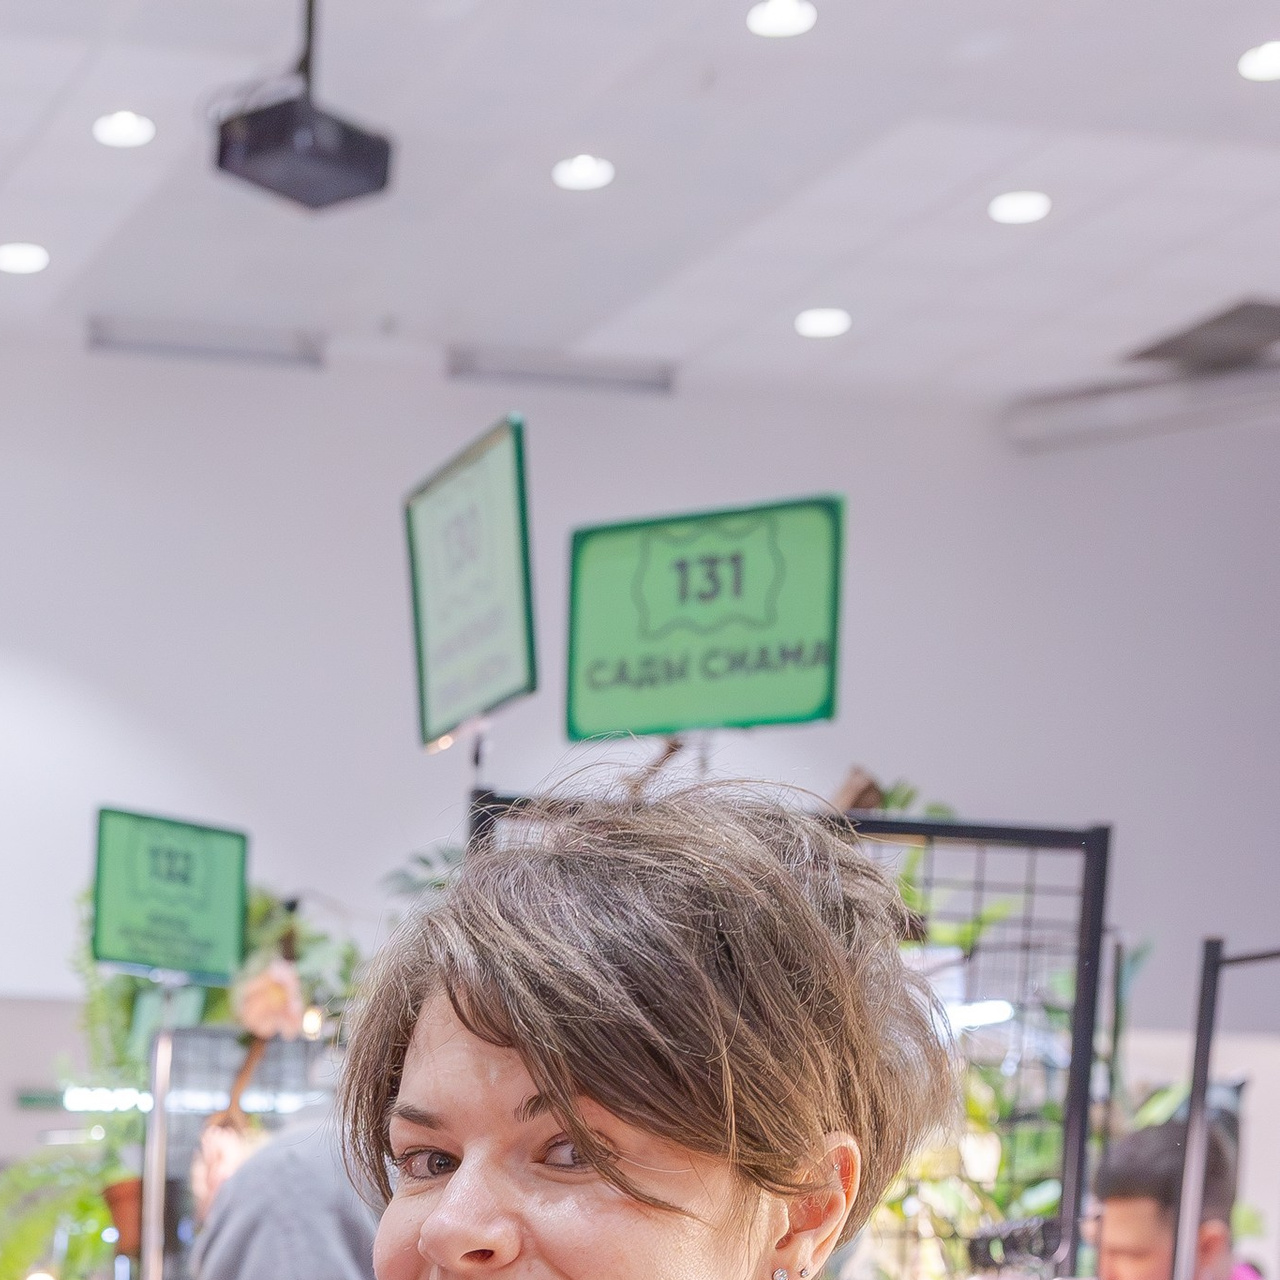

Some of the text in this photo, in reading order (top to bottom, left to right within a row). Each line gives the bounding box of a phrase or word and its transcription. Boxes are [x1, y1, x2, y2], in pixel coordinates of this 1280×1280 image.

[673, 550, 744, 605] 131
[587, 640, 833, 691] САДЫ СИАМА
